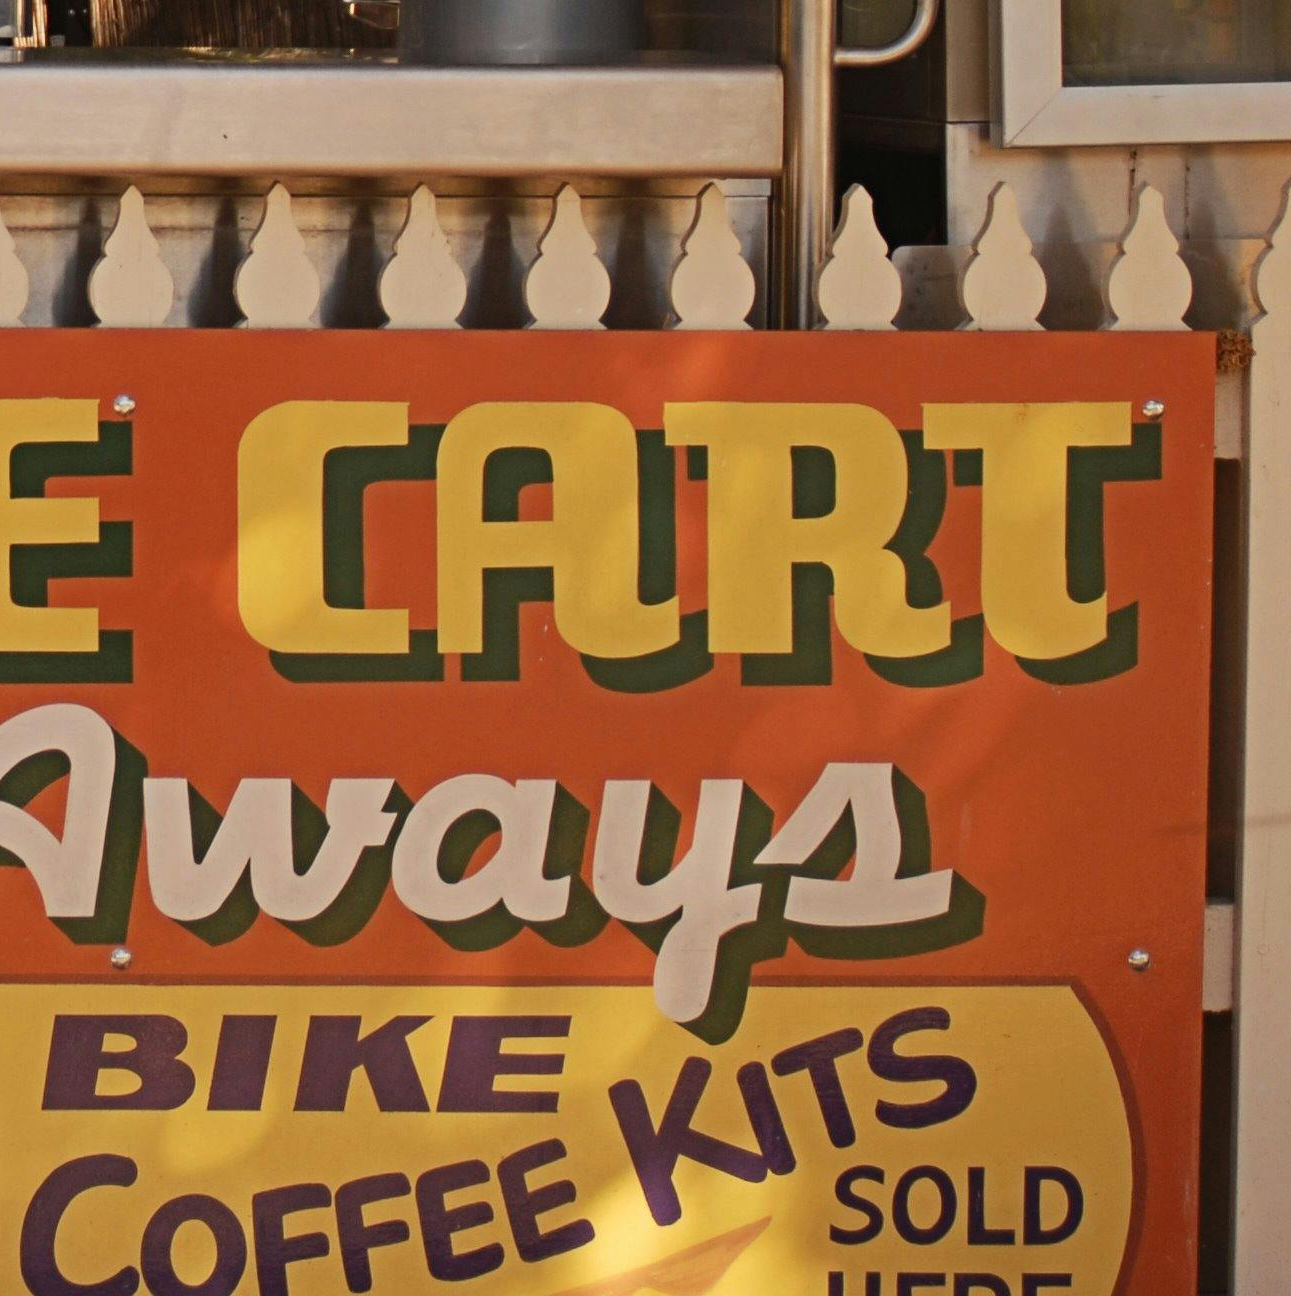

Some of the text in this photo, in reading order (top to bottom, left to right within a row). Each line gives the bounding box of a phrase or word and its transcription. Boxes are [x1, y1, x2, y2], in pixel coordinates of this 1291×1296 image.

[237, 399, 1133, 662] CART
[19, 1005, 979, 1296] COFFEE KITS
[40, 1014, 572, 1114] BIKE
[828, 1163, 1085, 1246] SOLD
